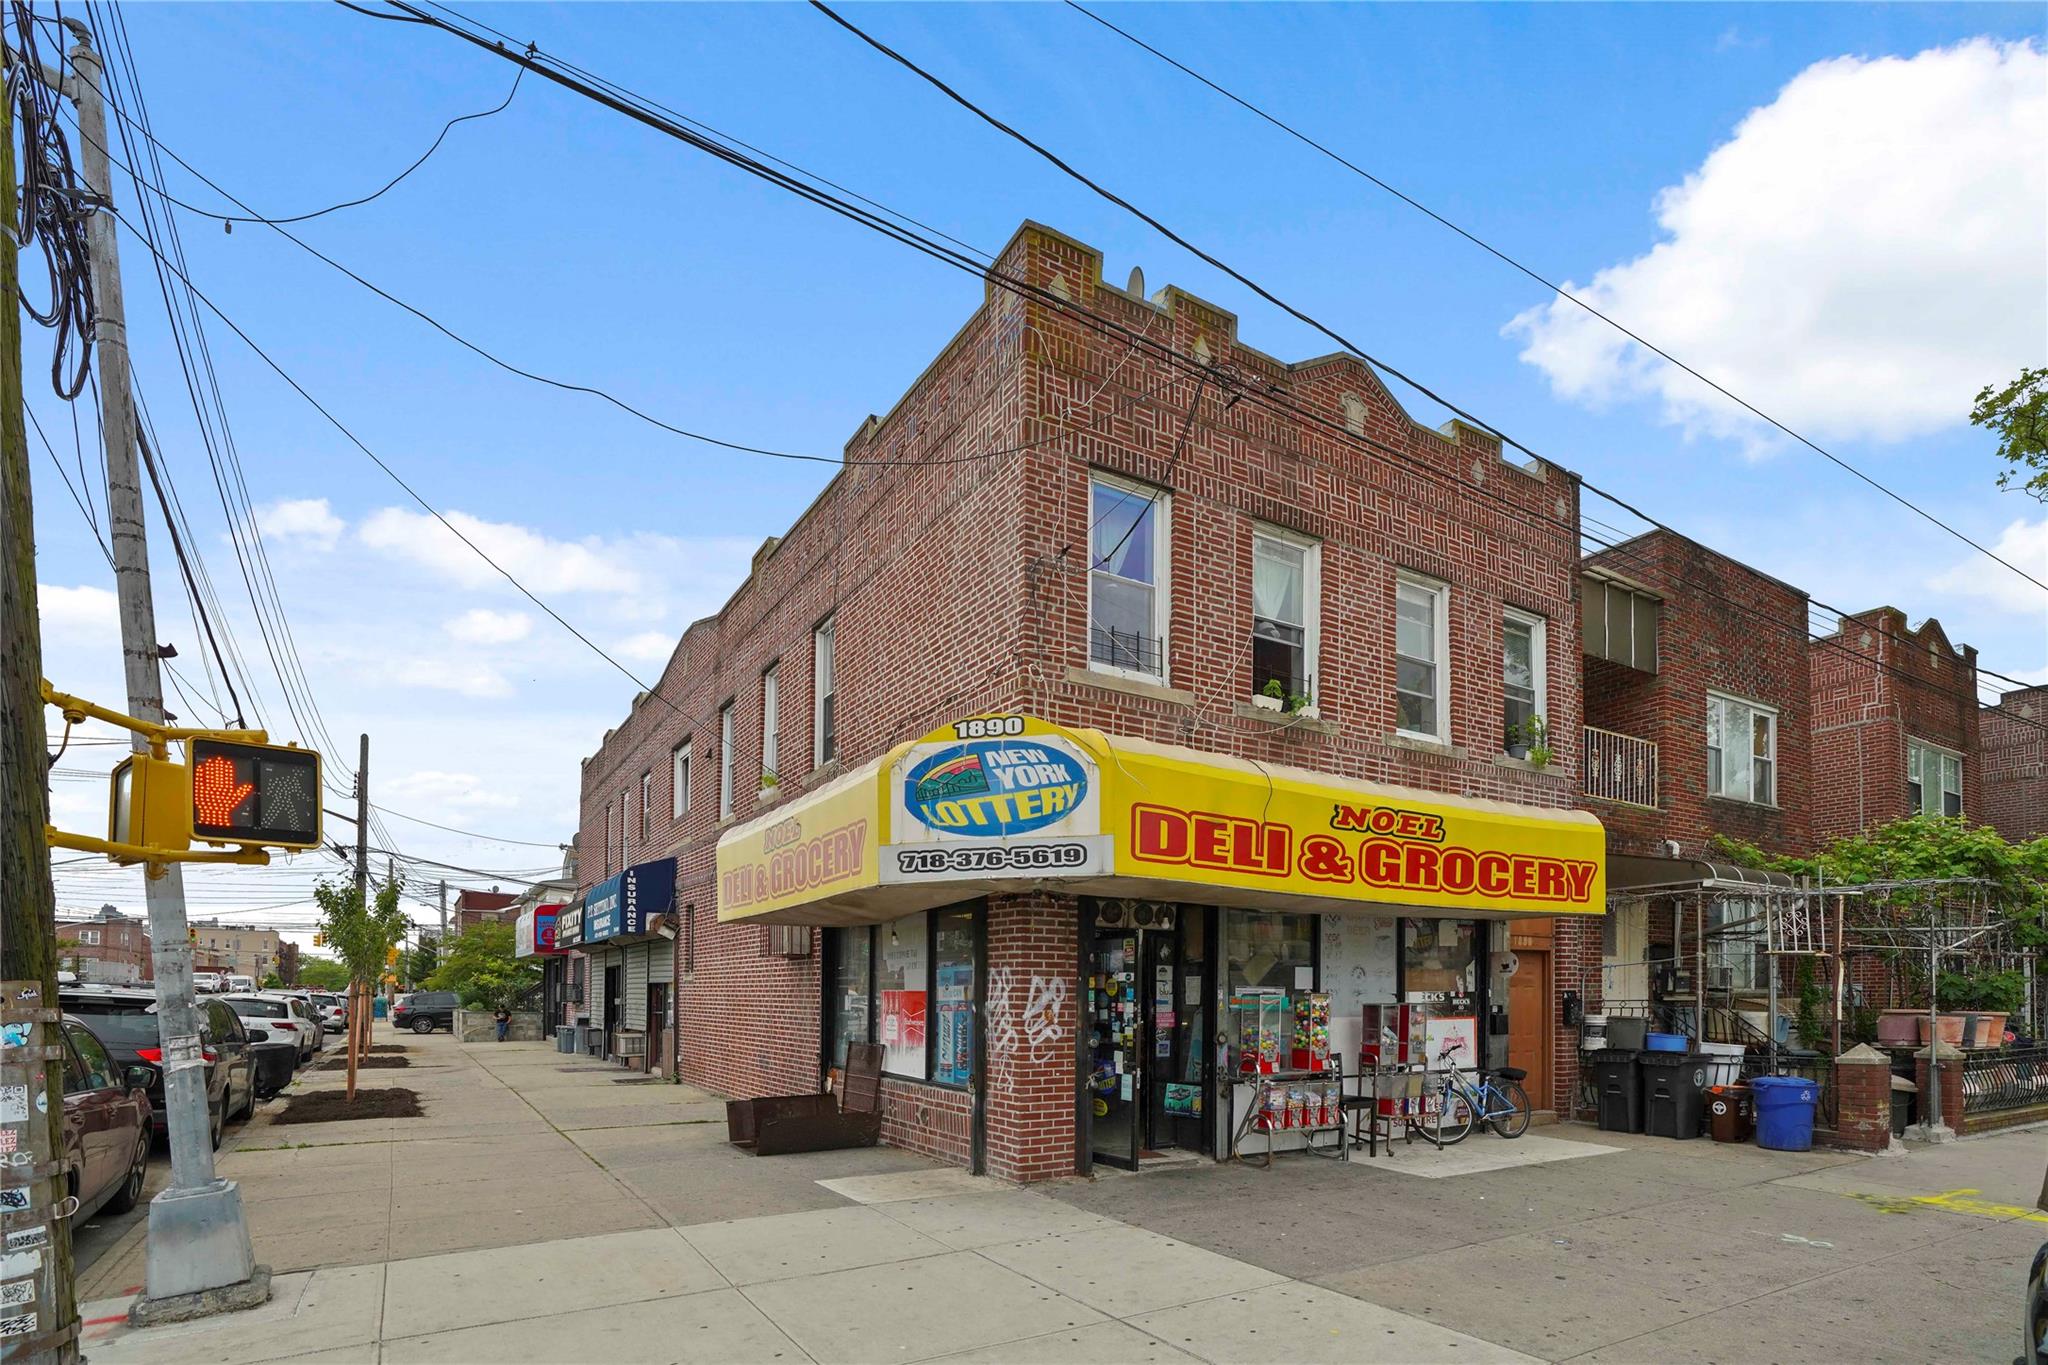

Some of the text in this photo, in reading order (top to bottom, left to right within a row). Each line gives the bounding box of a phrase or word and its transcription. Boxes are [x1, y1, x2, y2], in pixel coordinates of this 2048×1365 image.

[953, 716, 1024, 740] 1890
[986, 749, 1049, 767] NEW
[991, 763, 1071, 789] YORK
[920, 784, 1080, 827] LOTTERY
[1330, 803, 1446, 843] NOEL
[722, 818, 867, 910] DELI & GROCERY
[899, 843, 1087, 872] 718-376-5619
[1131, 802, 1598, 903] DELI & GROCERY
[561, 907, 583, 930] FIXITY
[627, 870, 636, 933] INSURANCE
